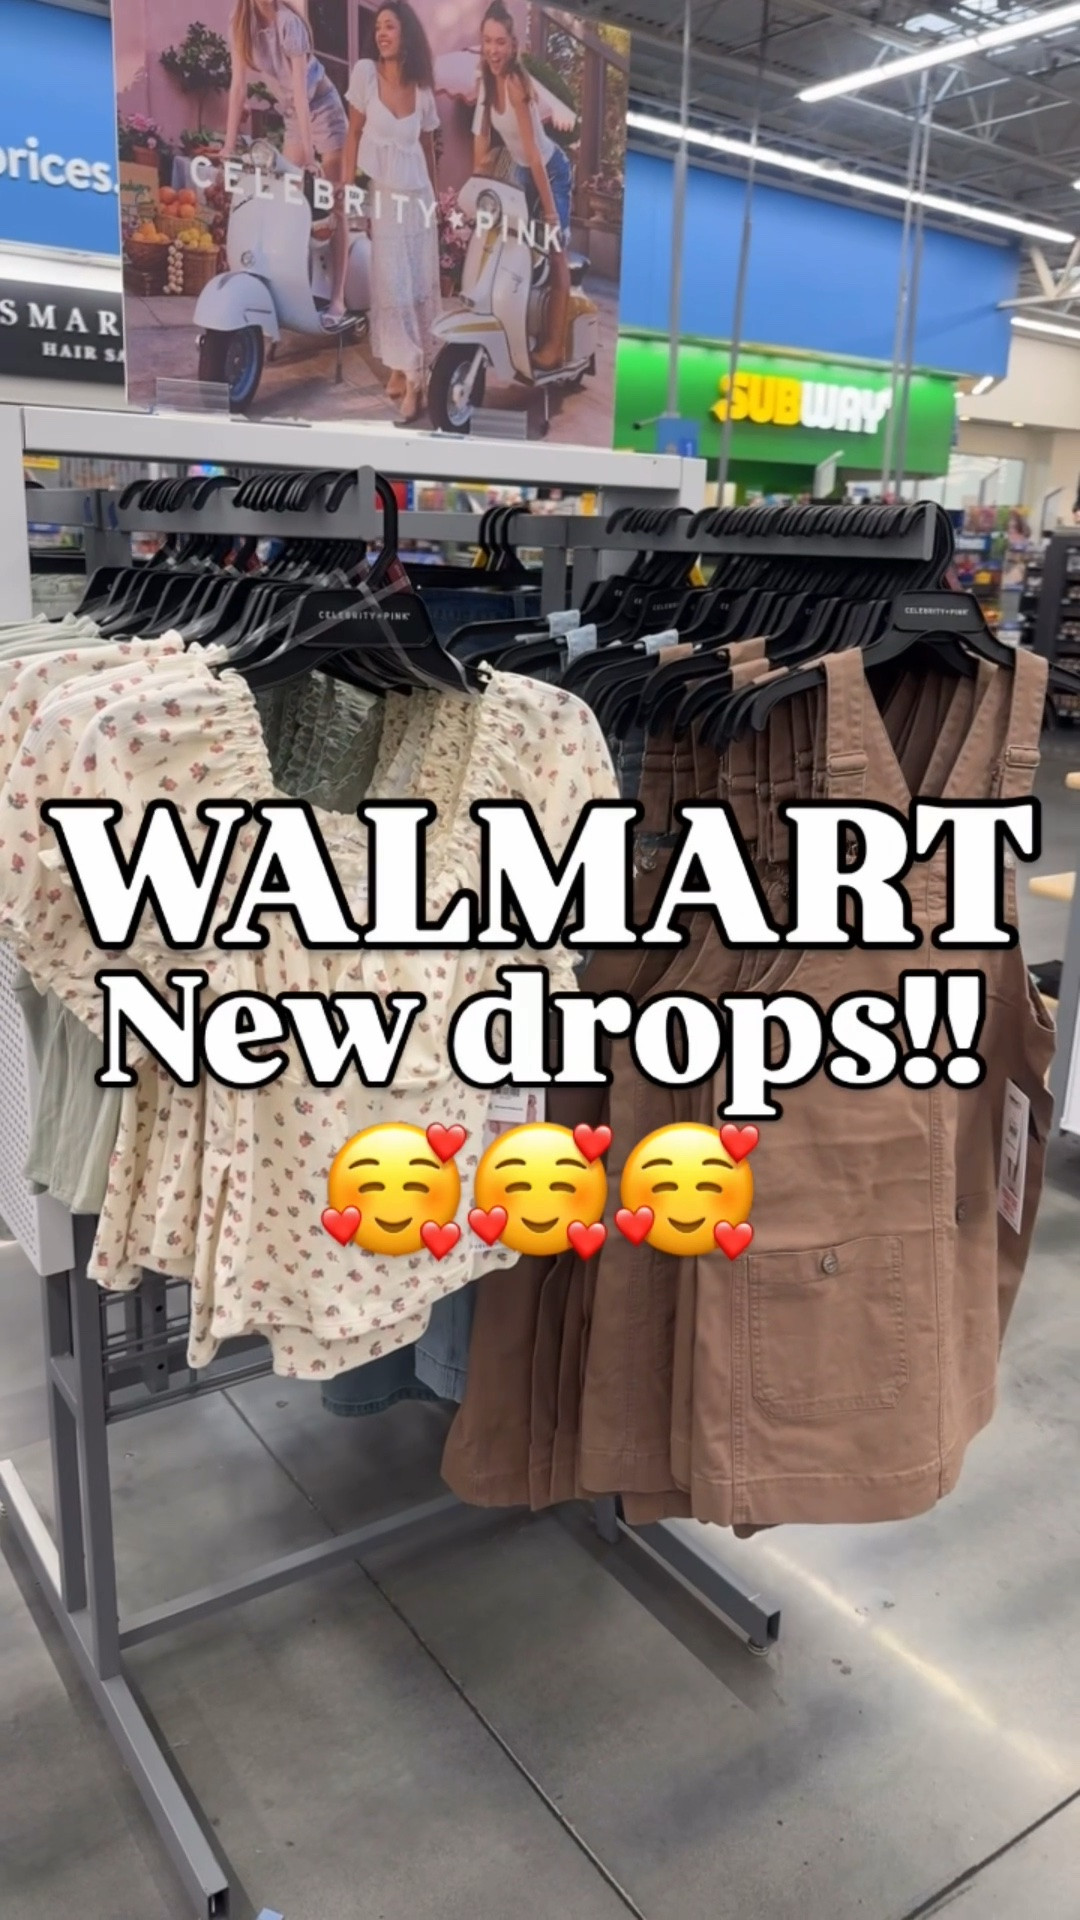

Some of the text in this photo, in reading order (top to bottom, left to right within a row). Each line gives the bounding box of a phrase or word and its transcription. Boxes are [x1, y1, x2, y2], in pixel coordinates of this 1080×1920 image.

[0, 136, 119, 193] rices.
[189, 155, 563, 253] CELEBRITY PINK
[42, 341, 97, 360] HAIR
[710, 370, 893, 434] SUBWAY
[318, 610, 410, 620] CELEBRITY PINK
[904, 606, 945, 615] CELEBRITY
